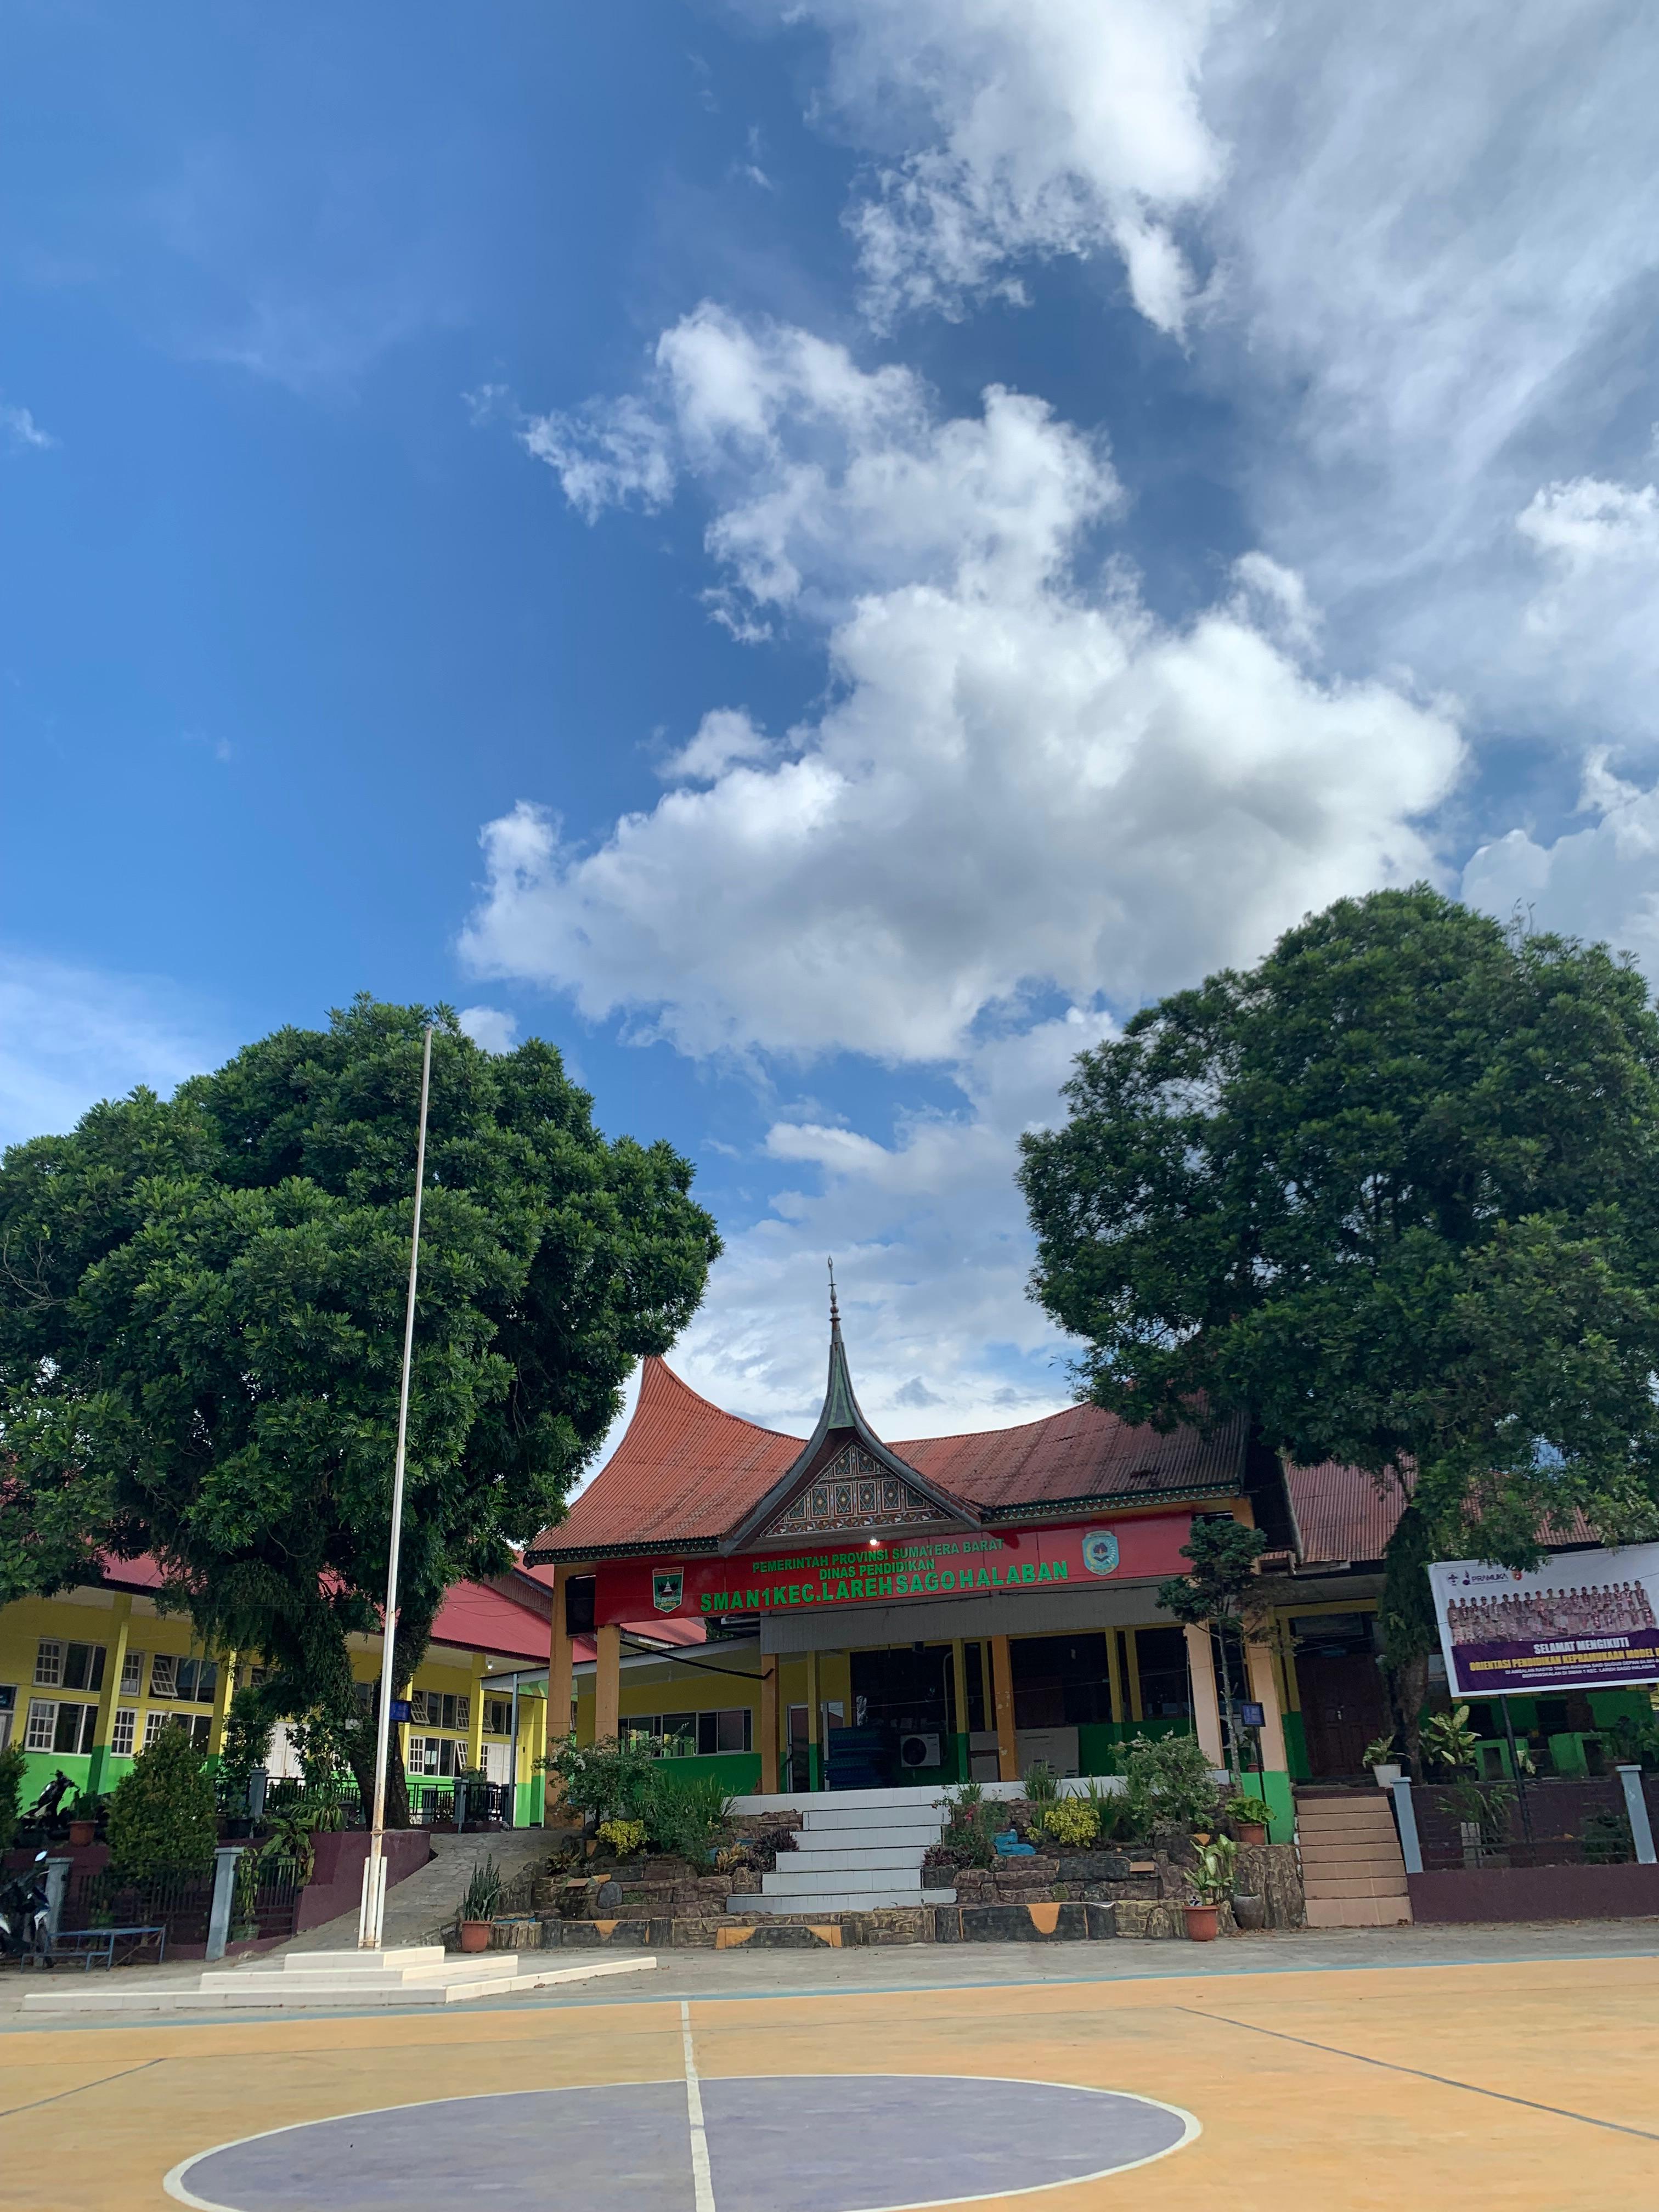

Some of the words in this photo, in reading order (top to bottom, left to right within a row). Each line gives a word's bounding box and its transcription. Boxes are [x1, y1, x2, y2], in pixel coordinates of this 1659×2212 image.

[753, 1556, 828, 1573] PEMERINTAH
[832, 1549, 888, 1565] PROVINSI
[892, 1543, 960, 1560] SUMATERA
[963, 1538, 1005, 1554] BARAT
[820, 1566, 856, 1580] DINAS
[859, 1559, 935, 1576] PENDIDIKAN
[896, 1570, 956, 1594] SAGO
[960, 1561, 1068, 1589] HALABAN
[1533, 1641, 1576, 1654] SELAMAT
[1576, 1637, 1630, 1651] MENGIKUTI
